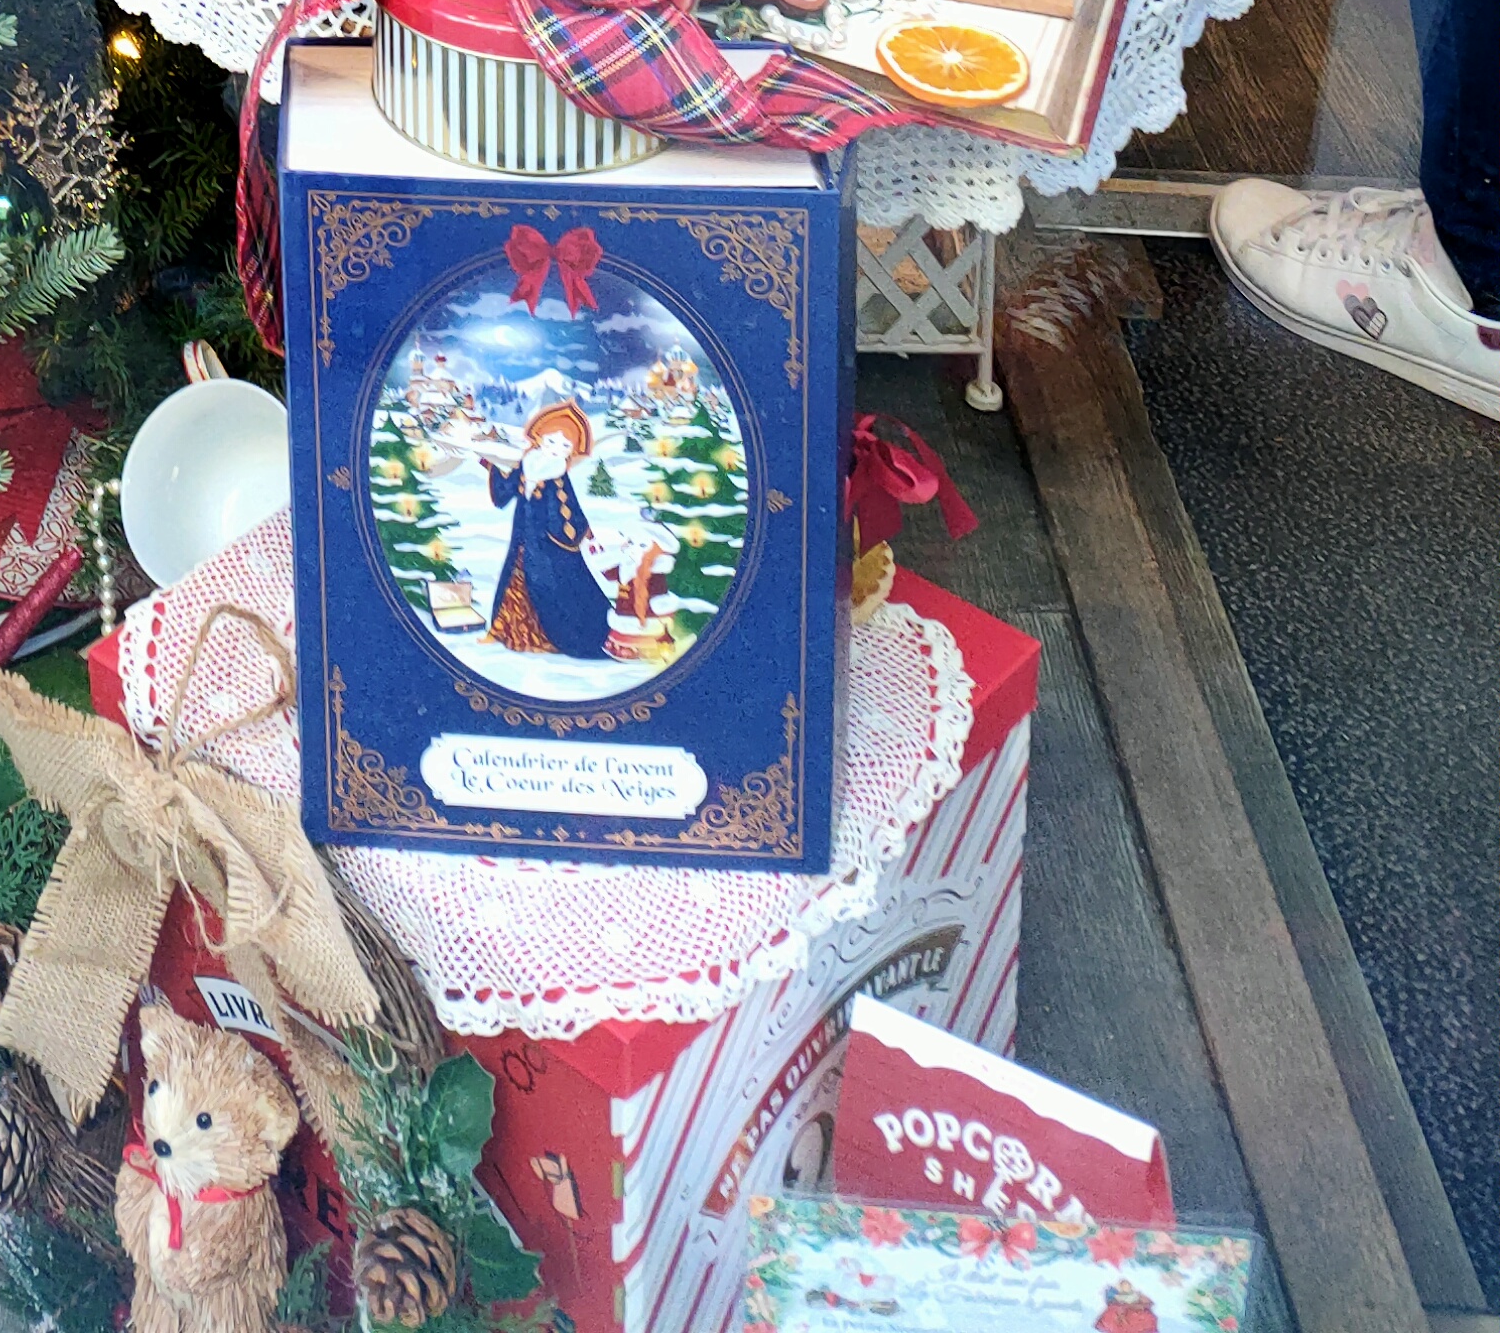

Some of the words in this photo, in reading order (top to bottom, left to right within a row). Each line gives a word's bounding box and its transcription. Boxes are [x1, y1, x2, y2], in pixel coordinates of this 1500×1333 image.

[452, 746, 570, 771] Calendrier
[574, 754, 598, 773] de
[605, 756, 675, 778] l'avent
[449, 769, 483, 794] Le
[479, 769, 555, 794] Coeur
[561, 774, 597, 795] des
[602, 778, 678, 807] Neiges
[206, 990, 276, 1031] LIVR
[718, 1154, 747, 1199] NE
[745, 1087, 785, 1152] PAS
[920, 947, 945, 974] LE
